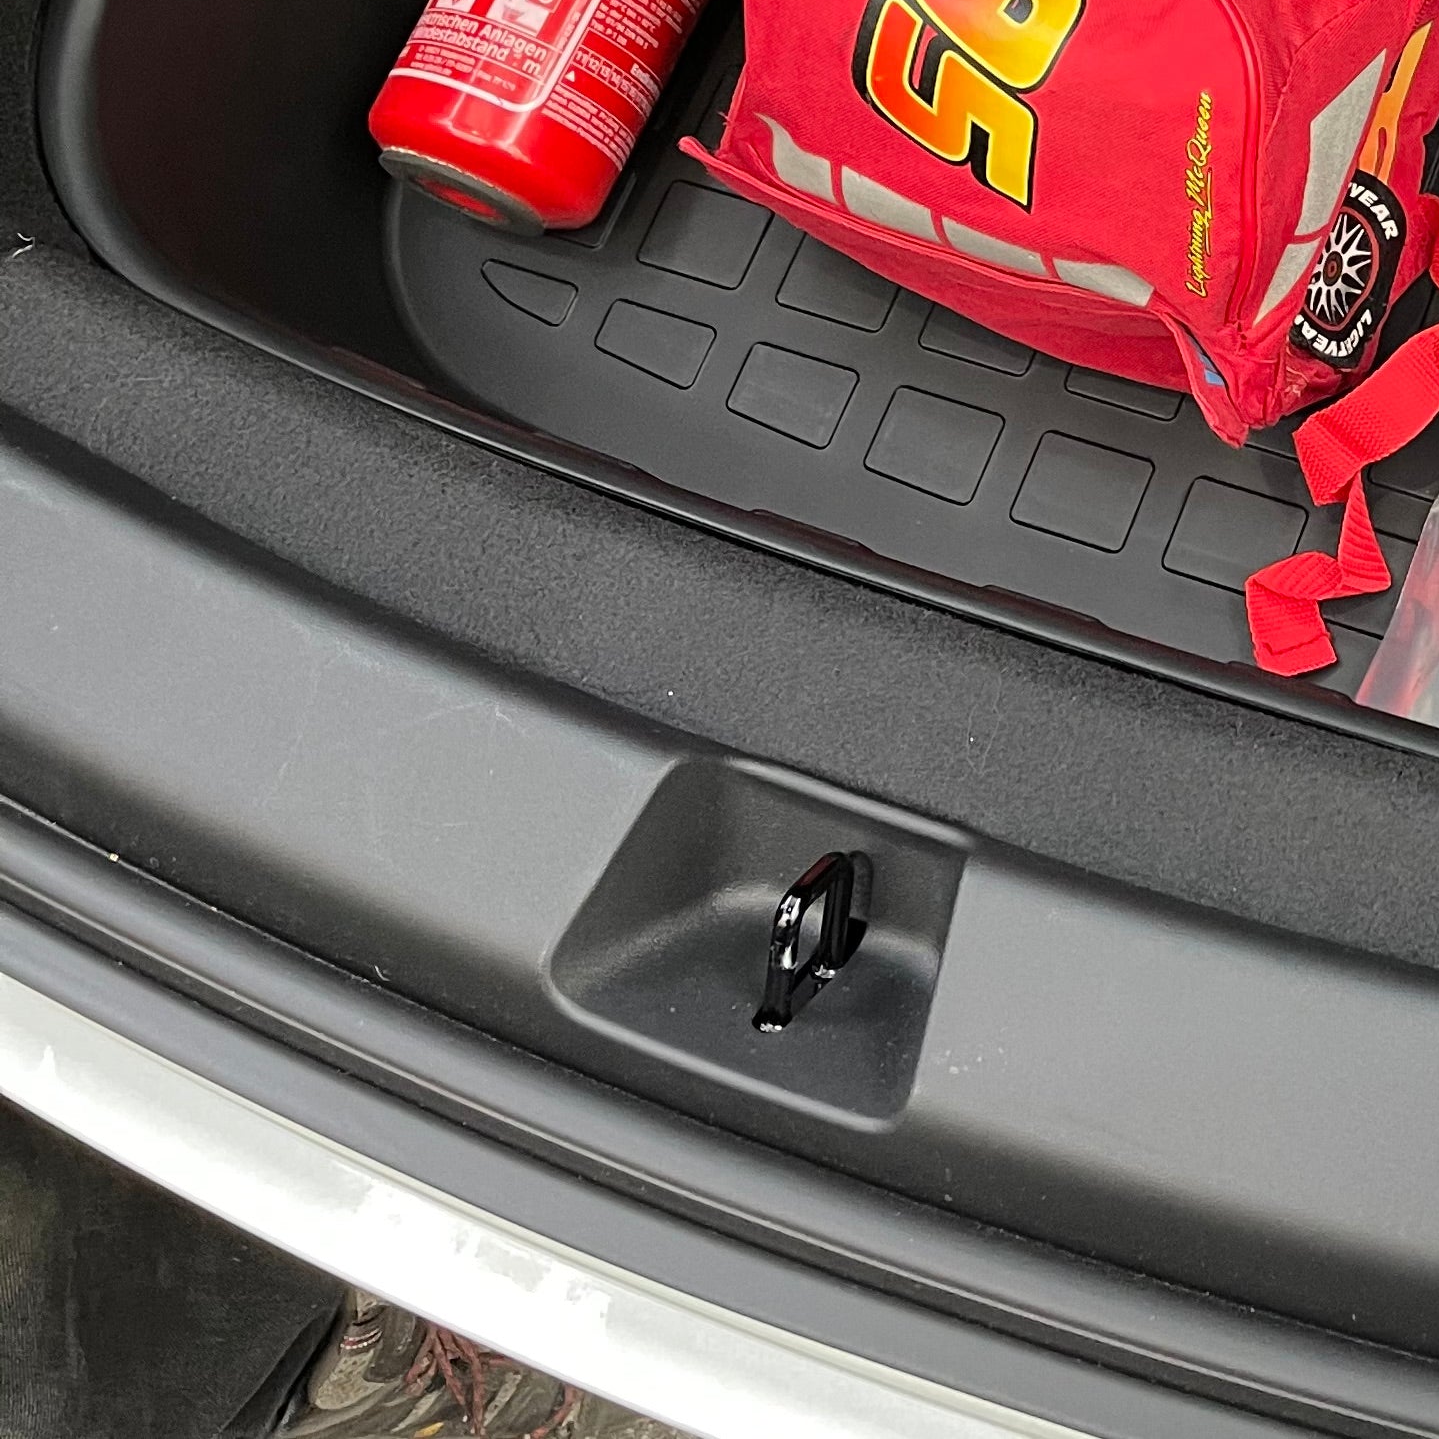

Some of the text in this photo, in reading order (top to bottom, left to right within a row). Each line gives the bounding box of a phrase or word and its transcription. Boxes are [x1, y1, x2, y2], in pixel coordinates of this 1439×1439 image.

[479, 23, 548, 61] Anlagen
[1184, 90, 1213, 299] Lightning McQueen
[1348, 180, 1400, 242] YEAR
